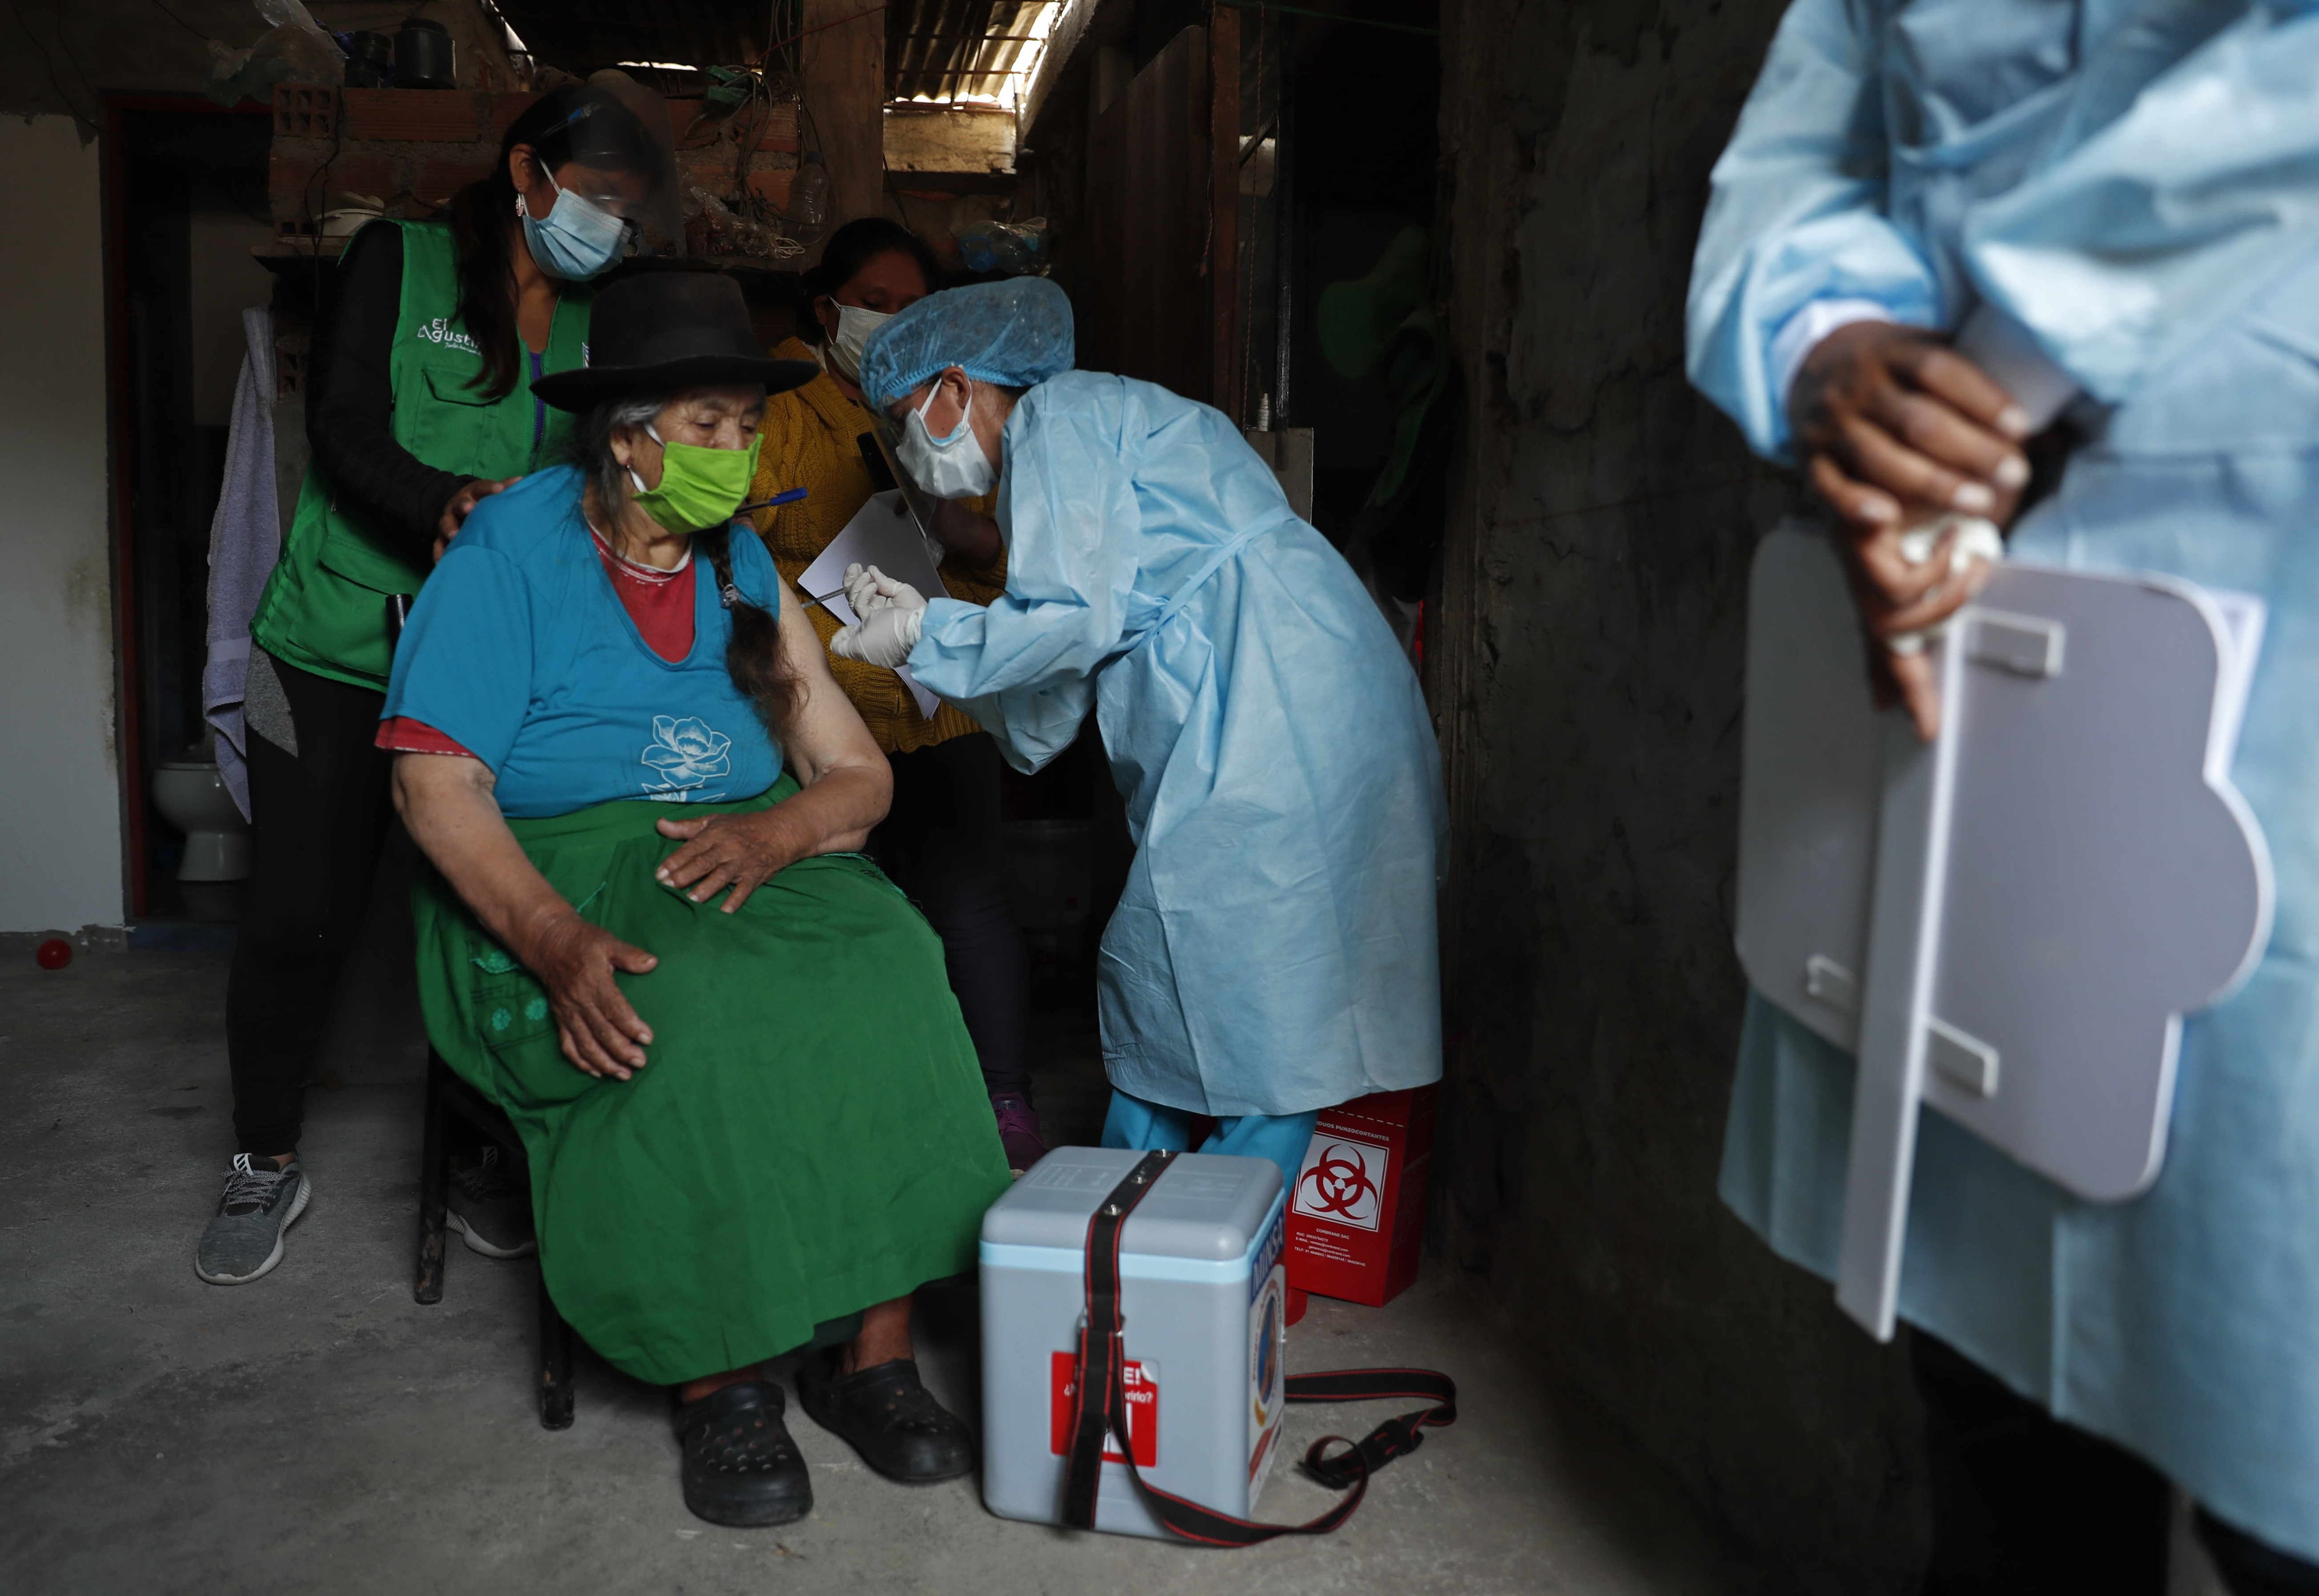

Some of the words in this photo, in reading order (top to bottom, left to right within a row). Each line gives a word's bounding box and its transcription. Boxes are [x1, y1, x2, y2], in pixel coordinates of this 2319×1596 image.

[432, 318, 447, 331] El
[1336, 1125, 1389, 1141] PUNZOCORTANTES
[1316, 1228, 1340, 1237] CORBRAND
